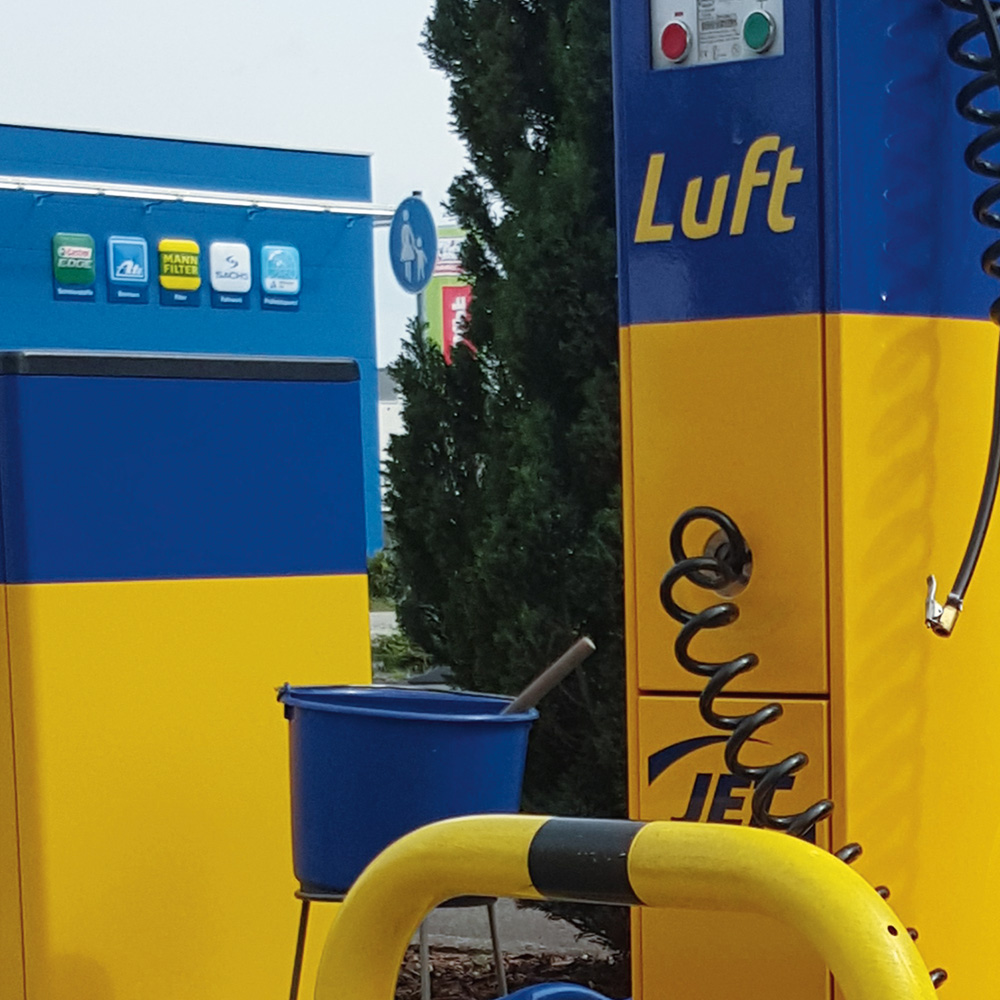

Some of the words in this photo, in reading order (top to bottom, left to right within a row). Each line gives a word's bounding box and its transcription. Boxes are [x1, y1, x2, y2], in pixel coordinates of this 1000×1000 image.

[634, 134, 804, 244] Luft
[57, 258, 94, 269] EDGE
[163, 254, 198, 265] MANN
[163, 264, 199, 275] FILTER
[215, 271, 249, 281] SACHS
[671, 772, 796, 827] JET
